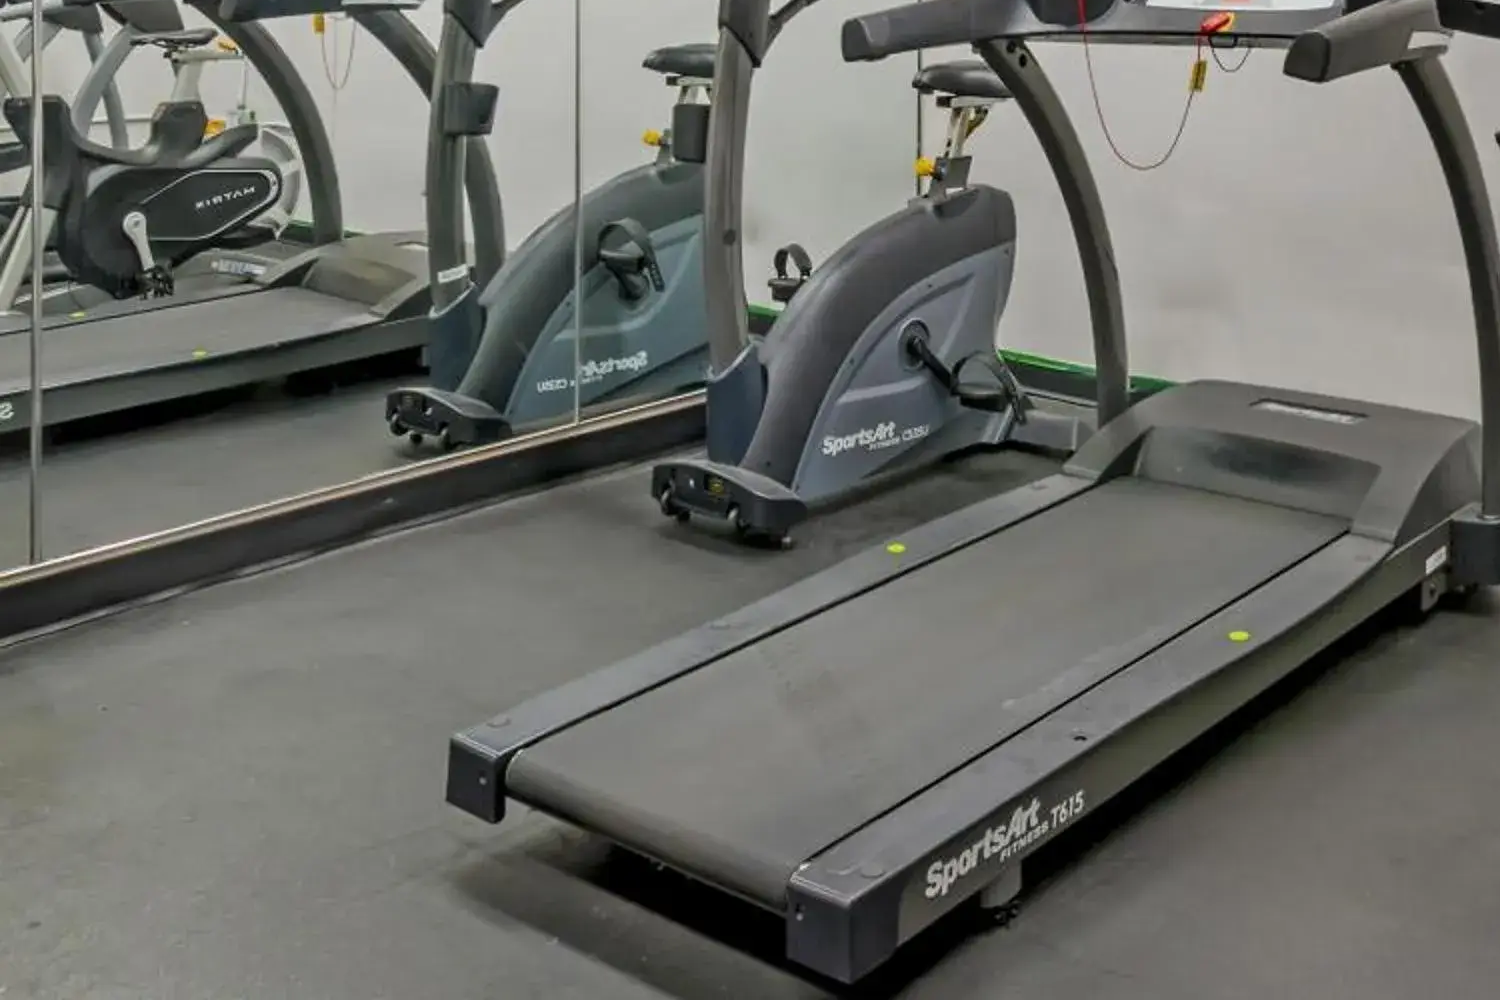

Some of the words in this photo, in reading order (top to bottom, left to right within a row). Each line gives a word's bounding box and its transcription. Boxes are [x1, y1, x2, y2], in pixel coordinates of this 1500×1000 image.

[822, 421, 896, 457] SportsArt
[925, 798, 1041, 898] SportsArt
[1000, 820, 1049, 863] FITNESS
[1050, 788, 1086, 829] T615
